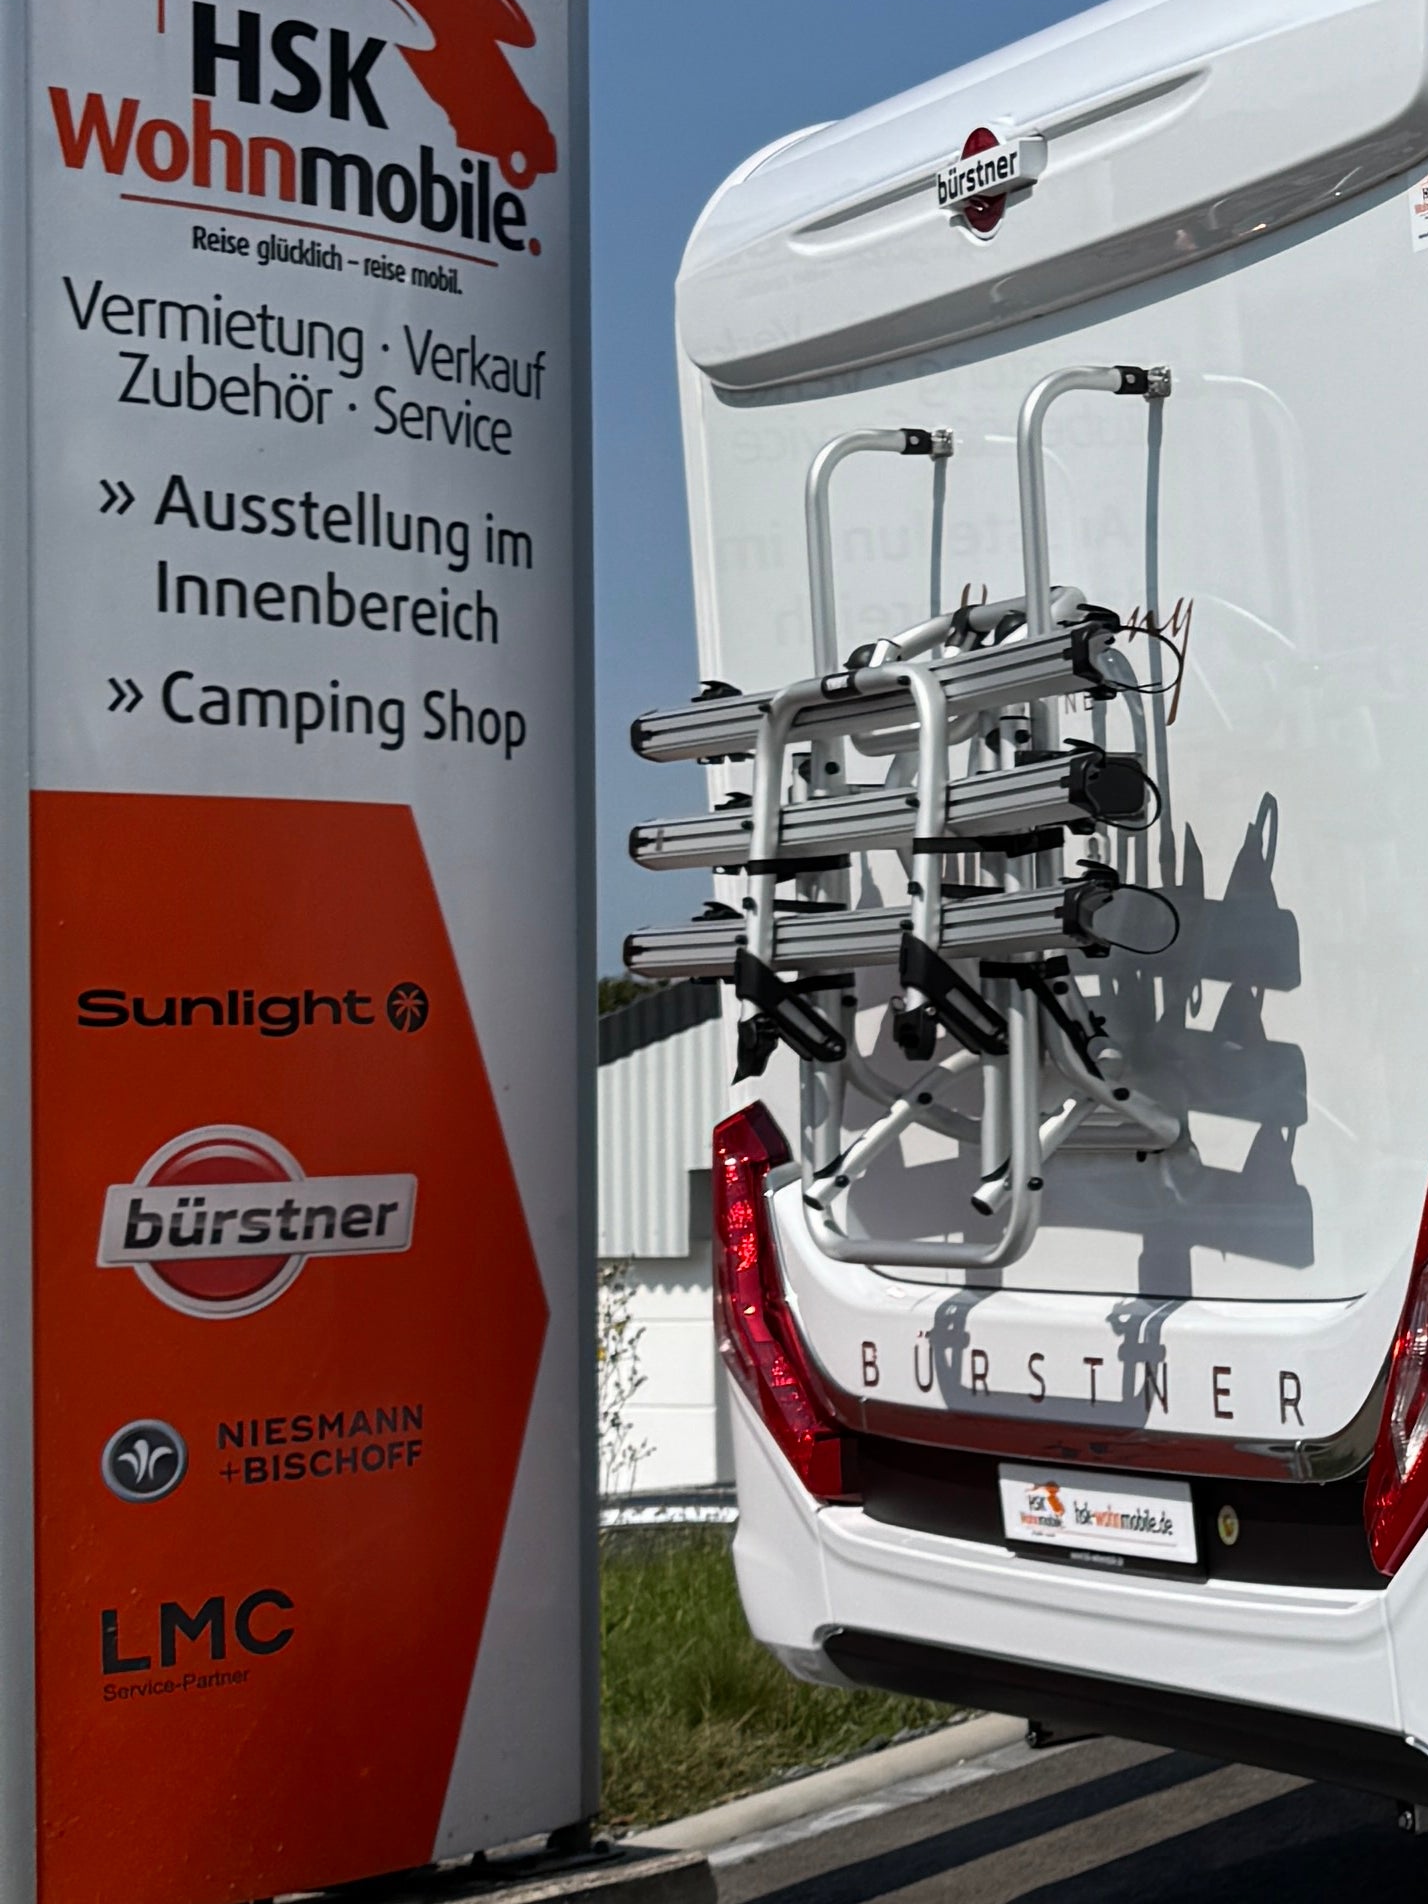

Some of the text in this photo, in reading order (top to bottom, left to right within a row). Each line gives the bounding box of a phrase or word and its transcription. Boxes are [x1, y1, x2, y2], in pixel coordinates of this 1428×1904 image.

[191, 0, 389, 130] HSK
[938, 151, 1018, 205] bürstner
[192, 226, 250, 259] Reise
[257, 235, 344, 274] glücklich
[364, 254, 406, 283] reise
[411, 265, 463, 295] mobil.
[64, 276, 366, 379] Vermietung
[403, 324, 546, 401] Verkauf
[118, 352, 332, 425] Zubehör
[375, 385, 513, 454] Service
[155, 473, 534, 572] Ausstellung im
[157, 560, 500, 644] Innenbereich
[161, 670, 528, 759] Camping Shop
[77, 988, 375, 1037] Sunlight
[123, 1197, 399, 1250] bürstner
[860, 1329, 1305, 1427] BÜRSTNER
[217, 1404, 425, 1450] NIESMANN
[101, 1589, 295, 1675] LMC
[103, 1667, 250, 1701] Service-Partner
